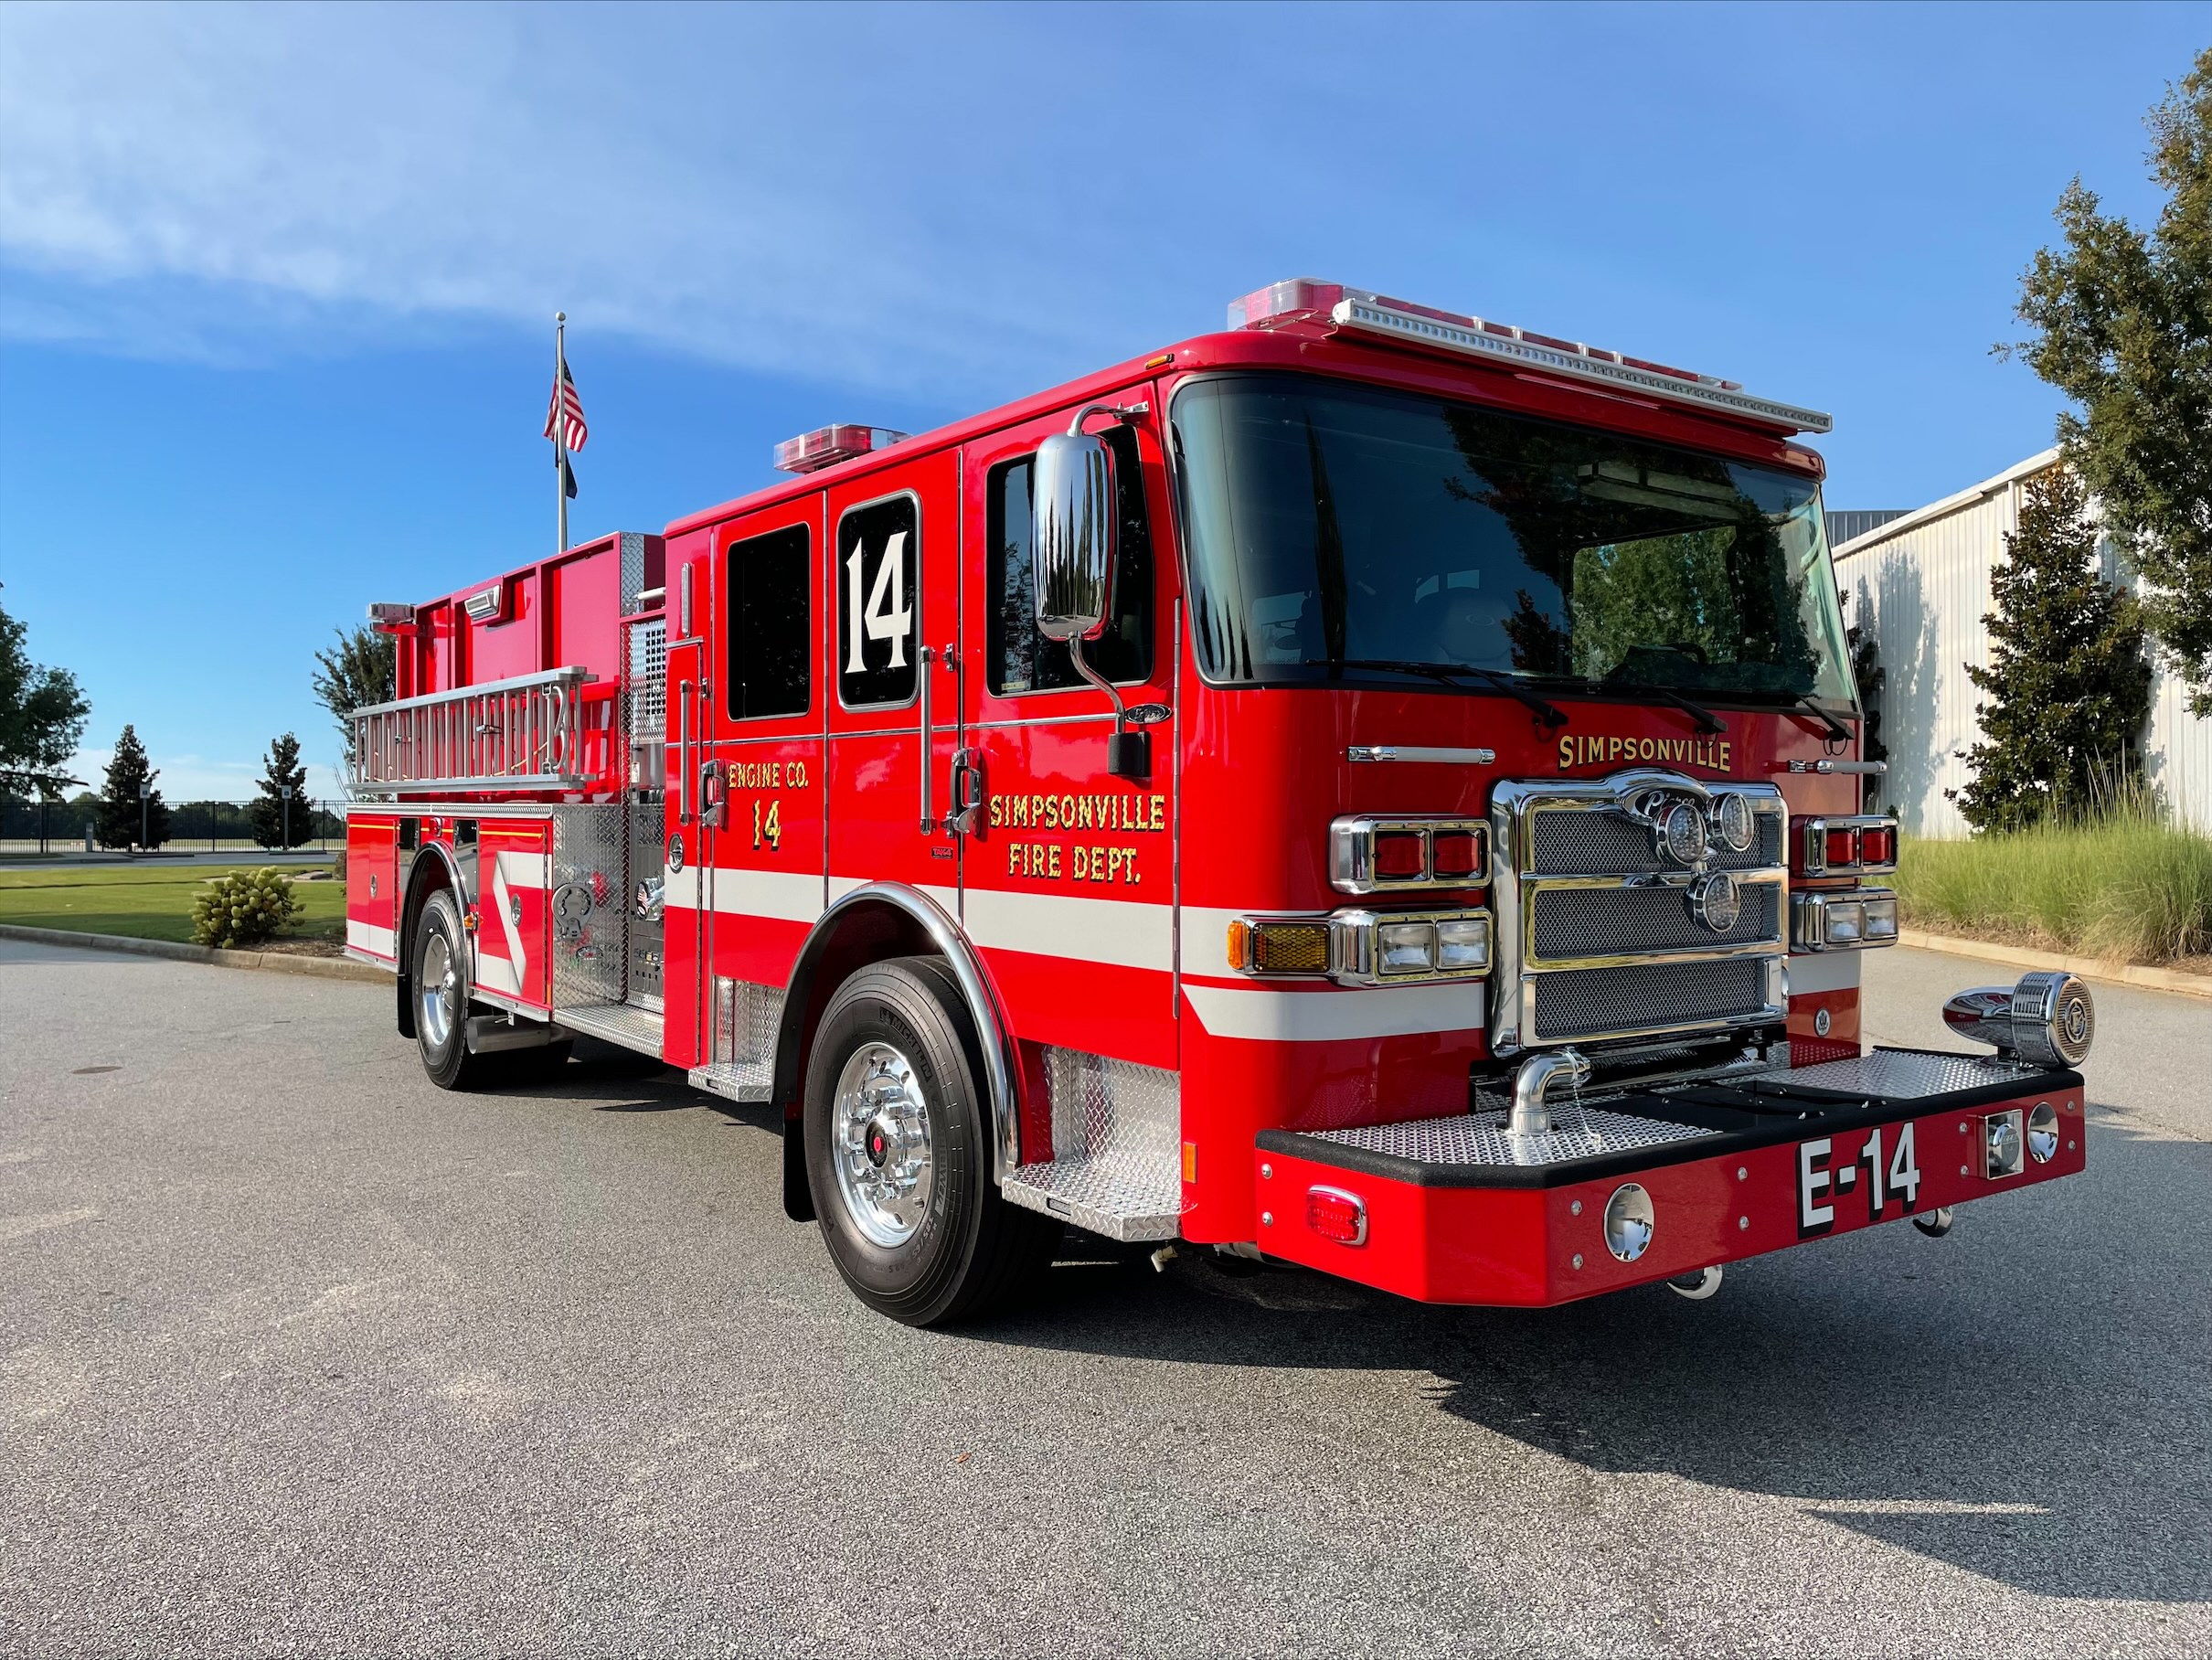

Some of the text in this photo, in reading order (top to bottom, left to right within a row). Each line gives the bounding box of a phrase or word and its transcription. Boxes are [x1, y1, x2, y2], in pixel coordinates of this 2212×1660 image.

[845, 530, 912, 674] 14
[1558, 735, 1731, 771] SIMPSONVILLE
[728, 761, 809, 789] ENGINE CO.
[753, 800, 782, 848] 14
[990, 794, 1165, 830] SIMPSONVILLE
[1009, 843, 1142, 883] FIRE DEPT.
[1799, 1122, 1920, 1229] E-14
